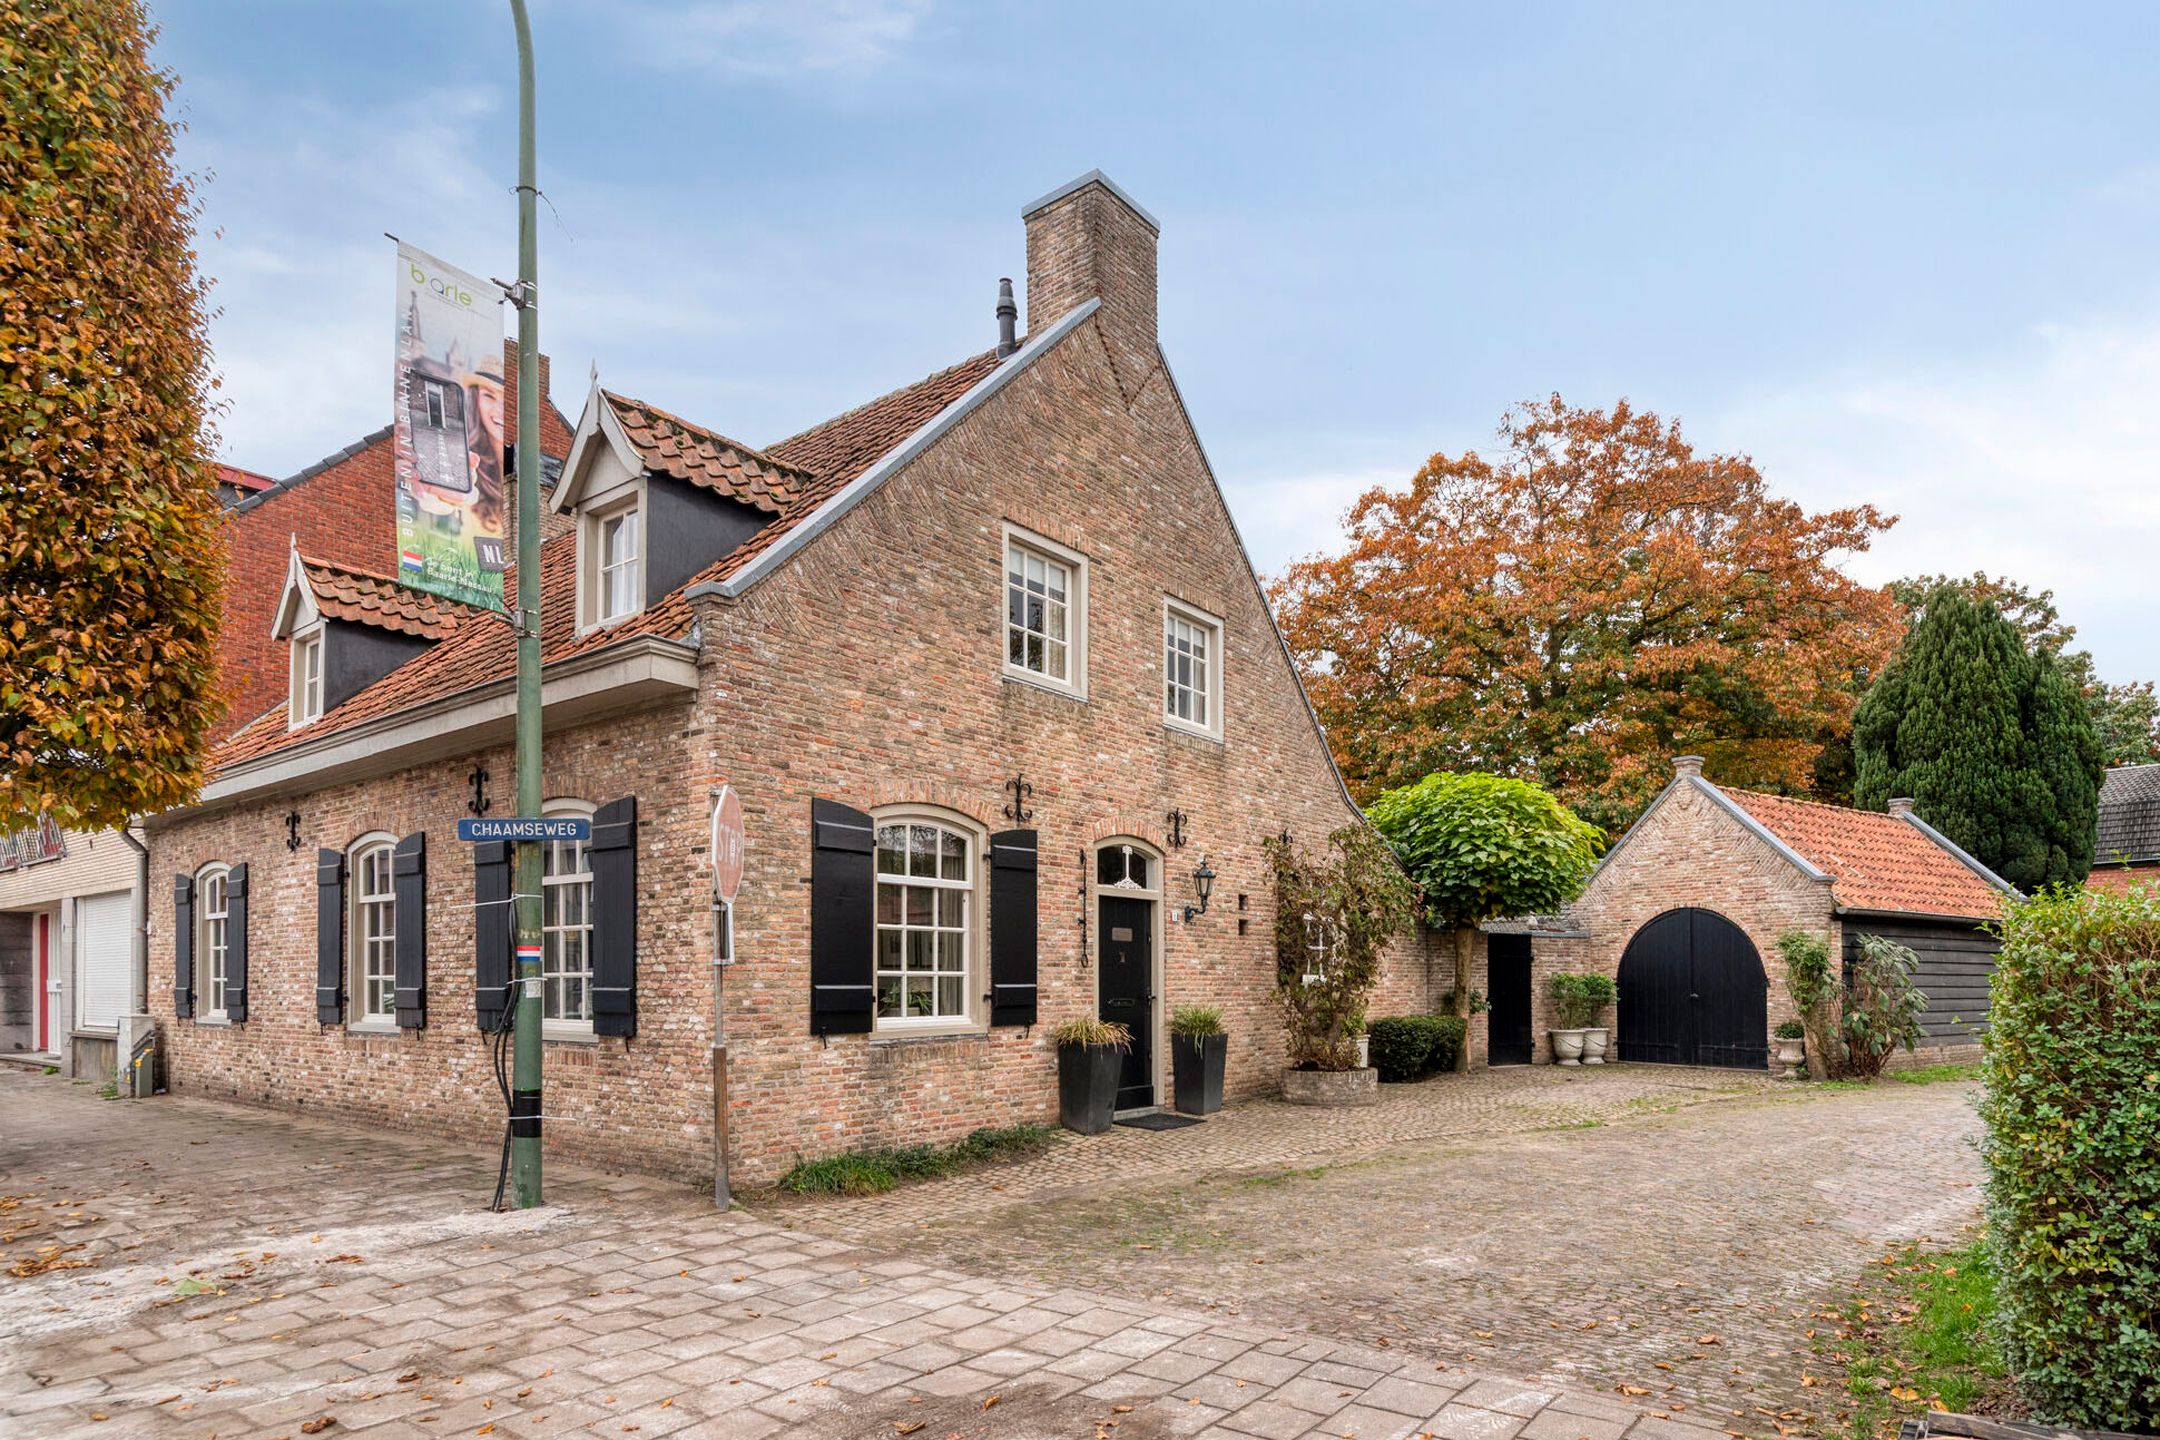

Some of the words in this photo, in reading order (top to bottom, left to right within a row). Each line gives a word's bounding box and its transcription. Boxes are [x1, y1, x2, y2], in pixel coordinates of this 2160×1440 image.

[400, 435, 412, 456] IN
[400, 466, 414, 536] BUITEN
[482, 544, 504, 564] NL
[472, 823, 576, 836] CHAAMSEWEG
[718, 823, 743, 868] STOP
